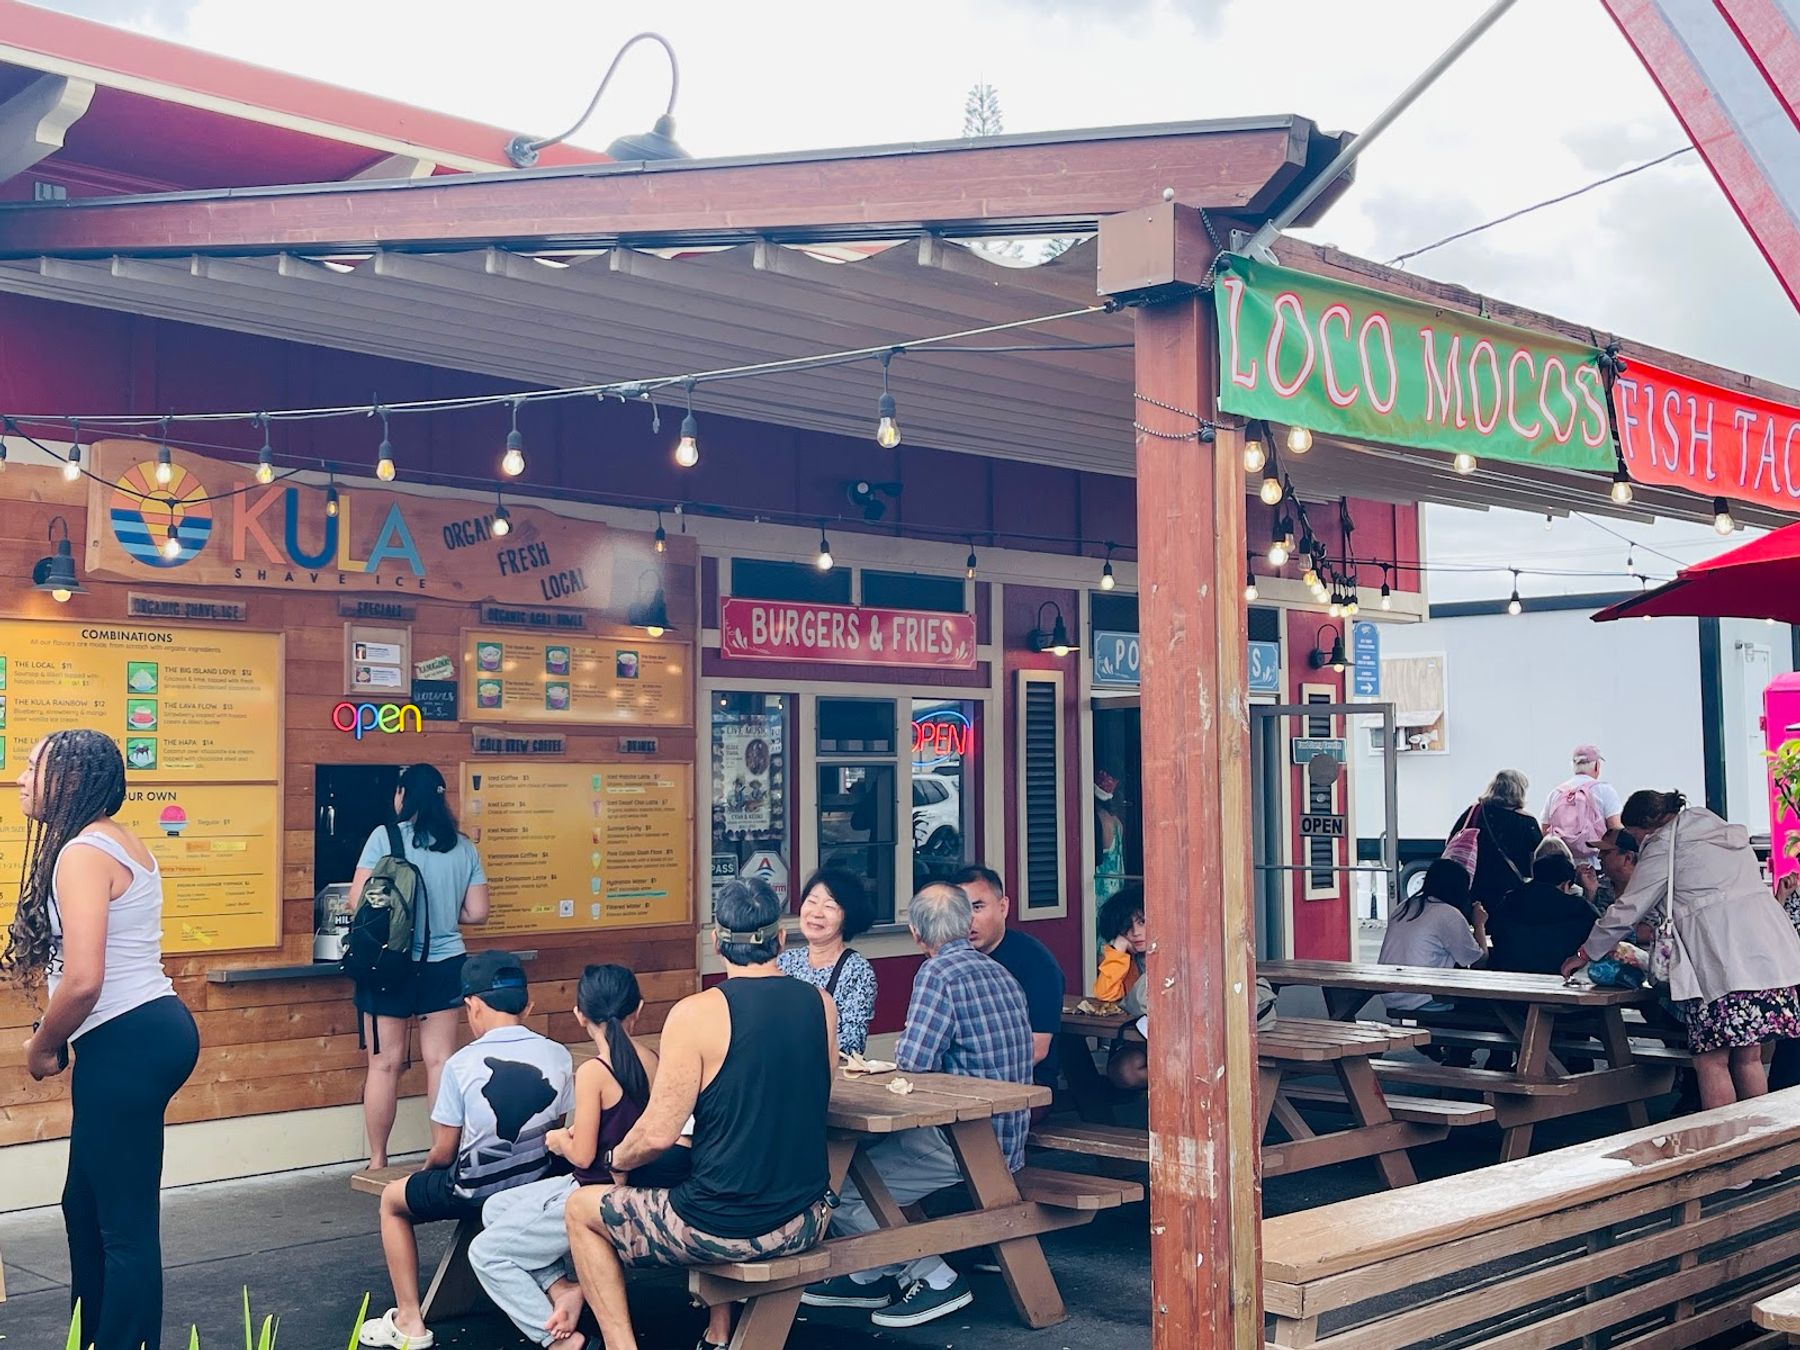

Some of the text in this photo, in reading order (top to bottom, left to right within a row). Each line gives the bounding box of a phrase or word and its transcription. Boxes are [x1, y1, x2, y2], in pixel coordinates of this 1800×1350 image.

[1222, 275, 1608, 448] LOCO MOCOS
[1616, 377, 1717, 482] FISH
[232, 481, 427, 577] KULA
[443, 509, 513, 550] ORGAN
[497, 541, 551, 577] FRESH
[234, 567, 427, 589] SHAVE ICE
[540, 567, 589, 601] LOCAL
[81, 629, 173, 643] COMBINATIONS
[752, 607, 954, 655] BURGERS & FRIES
[14, 660, 29, 668] THE
[31, 660, 56, 669] LOCAL
[193, 667, 218, 675] ISLAND
[219, 668, 236, 676] LOVE
[14, 698, 29, 706] THE
[30, 699, 51, 707] KULA
[52, 699, 88, 708] RAINBOW
[332, 701, 422, 740] open
[124, 792, 177, 801] UR OWN
[1301, 816, 1343, 834] OPEN
